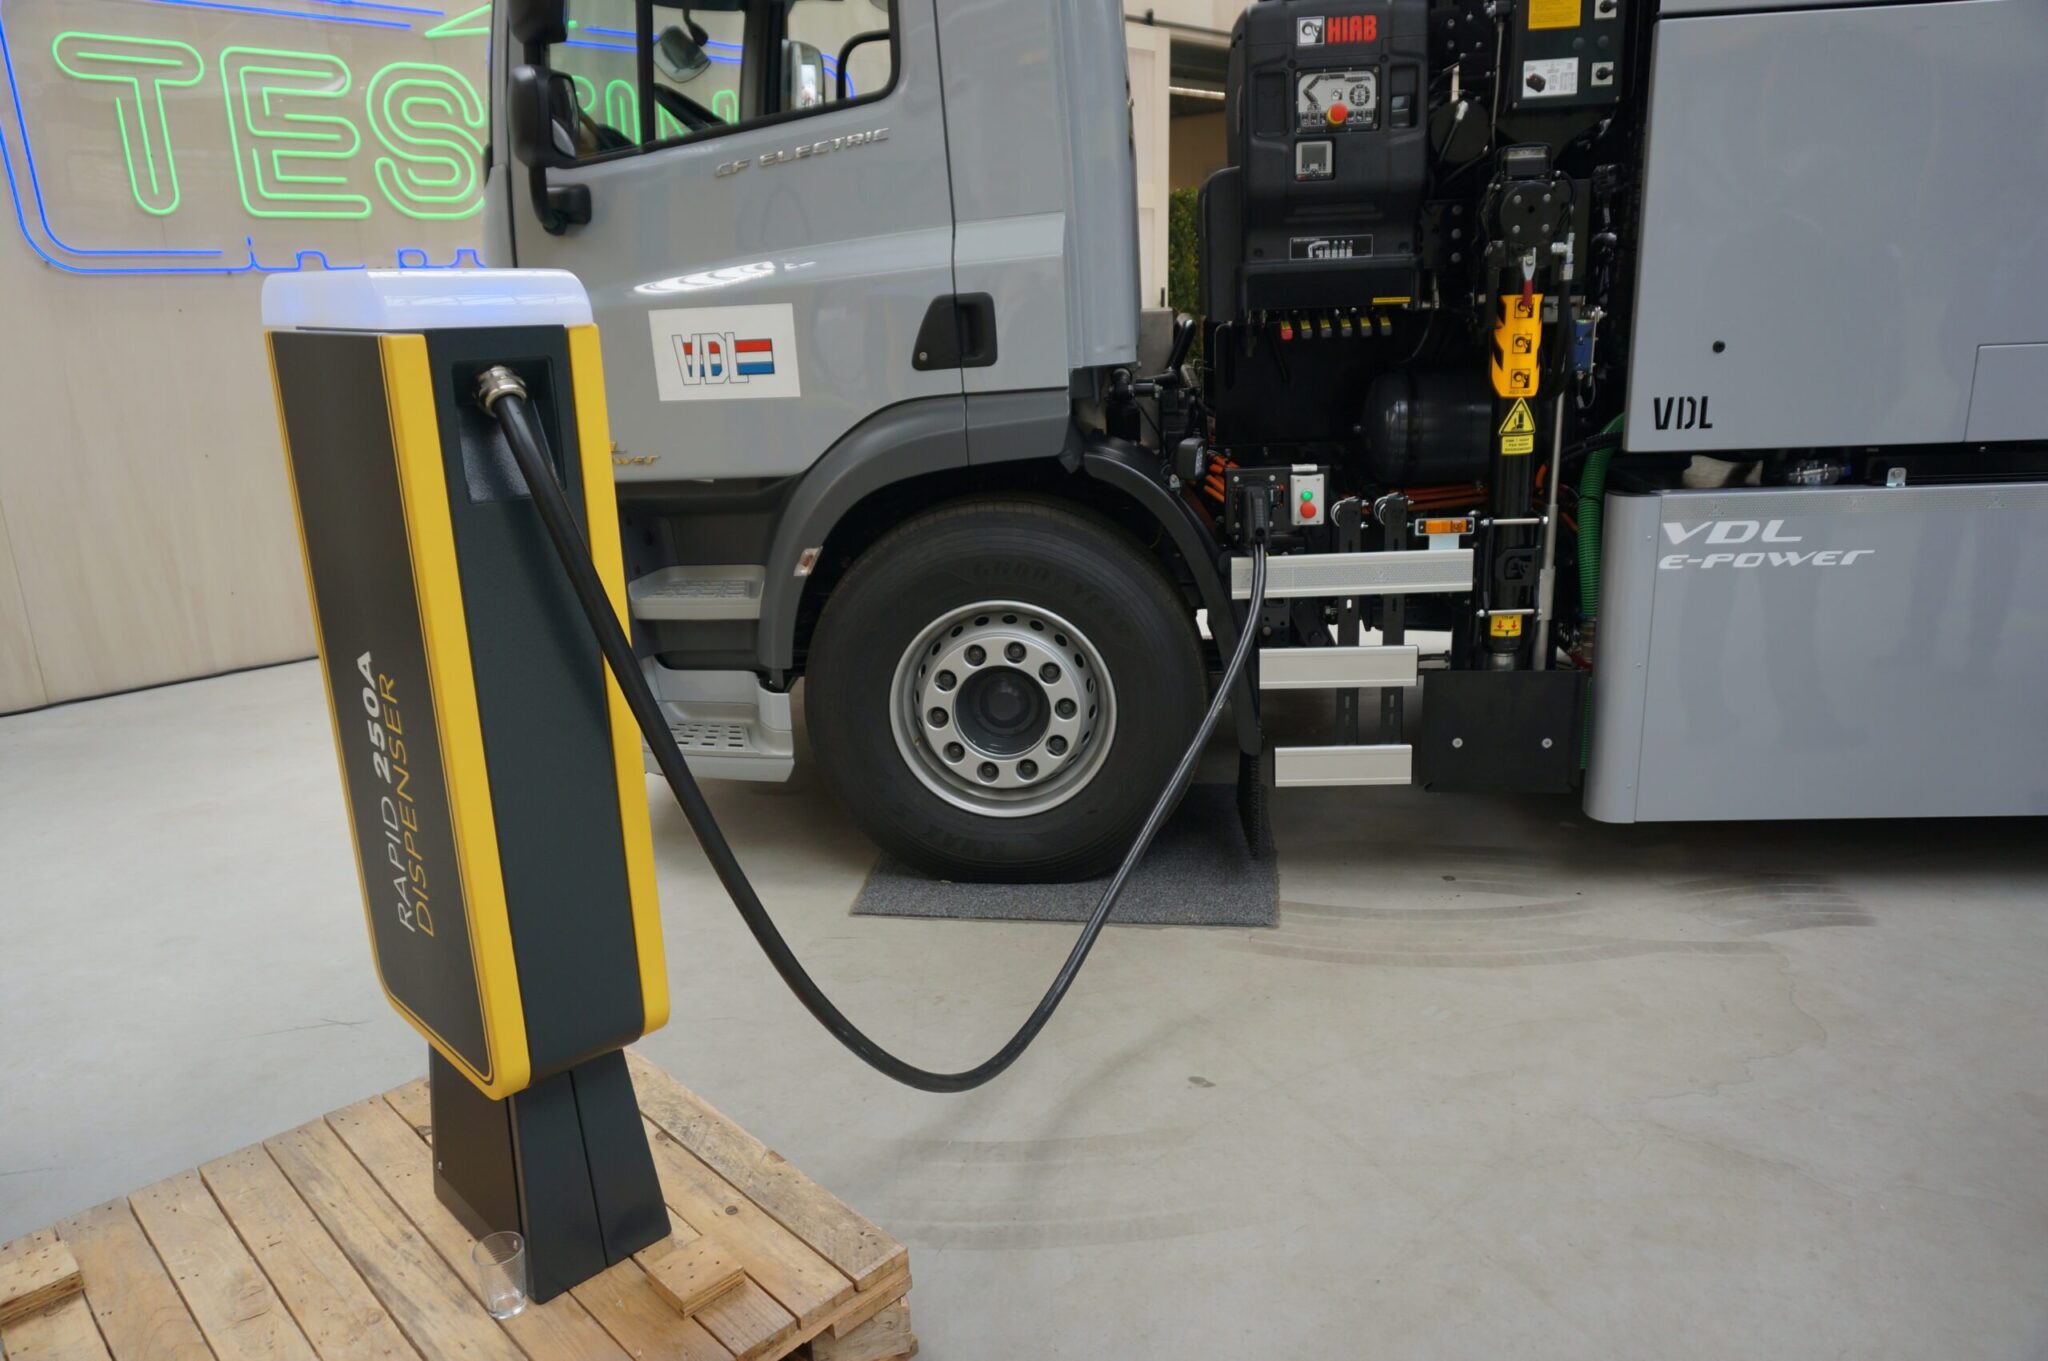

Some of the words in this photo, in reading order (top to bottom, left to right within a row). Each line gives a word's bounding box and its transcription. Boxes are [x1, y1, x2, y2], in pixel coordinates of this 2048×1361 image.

[1327, 15, 1377, 43] HIAB
[715, 158, 752, 178] CF
[759, 127, 890, 167] ELECTRIC
[671, 331, 750, 385] VDL
[1653, 395, 1713, 430] VDL
[1662, 519, 1803, 545] VDL
[357, 651, 391, 784] 250A
[379, 673, 434, 937] DISPENSER
[382, 796, 415, 932] RAPID
